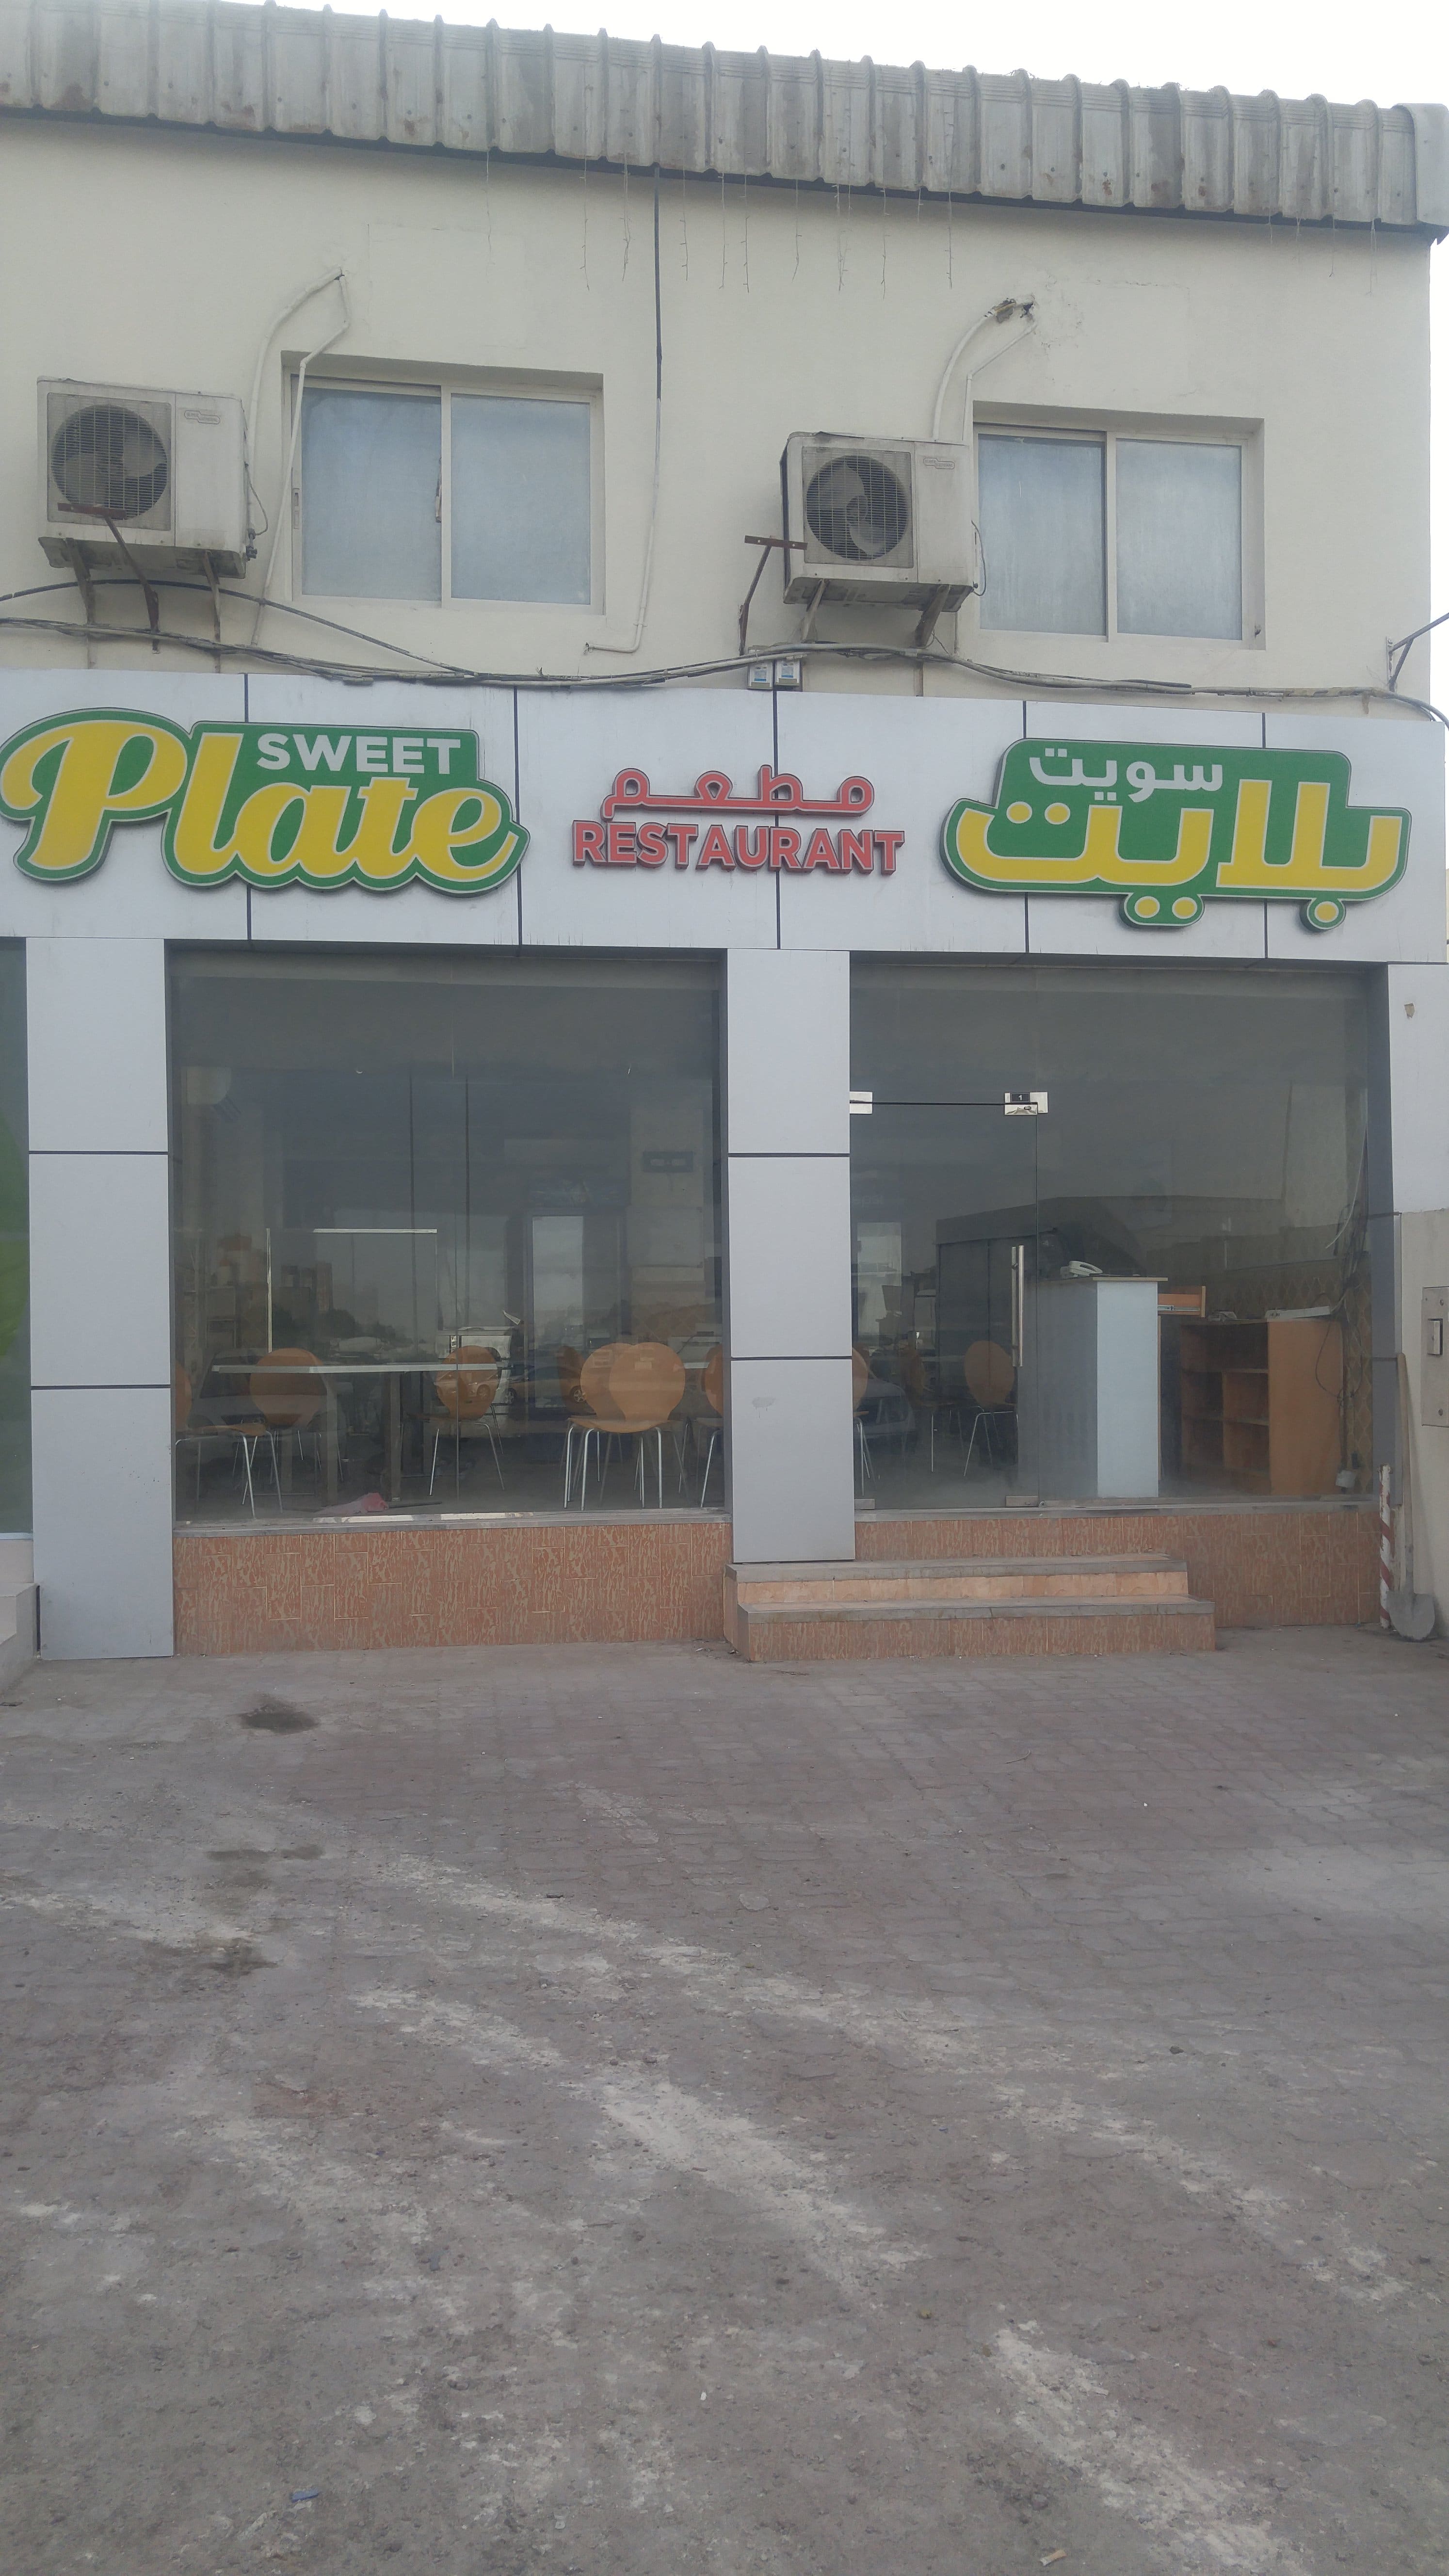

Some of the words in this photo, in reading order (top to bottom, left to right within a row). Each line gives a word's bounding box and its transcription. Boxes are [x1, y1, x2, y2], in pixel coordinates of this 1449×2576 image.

[257, 733, 461, 774] SWEET
[1029, 748, 1223, 803] سويت
[0, 720, 519, 880] Plate
[600, 765, 874, 821] مطعم
[572, 820, 905, 874] RESTAURANT
[956, 779, 1403, 919] بلايت
